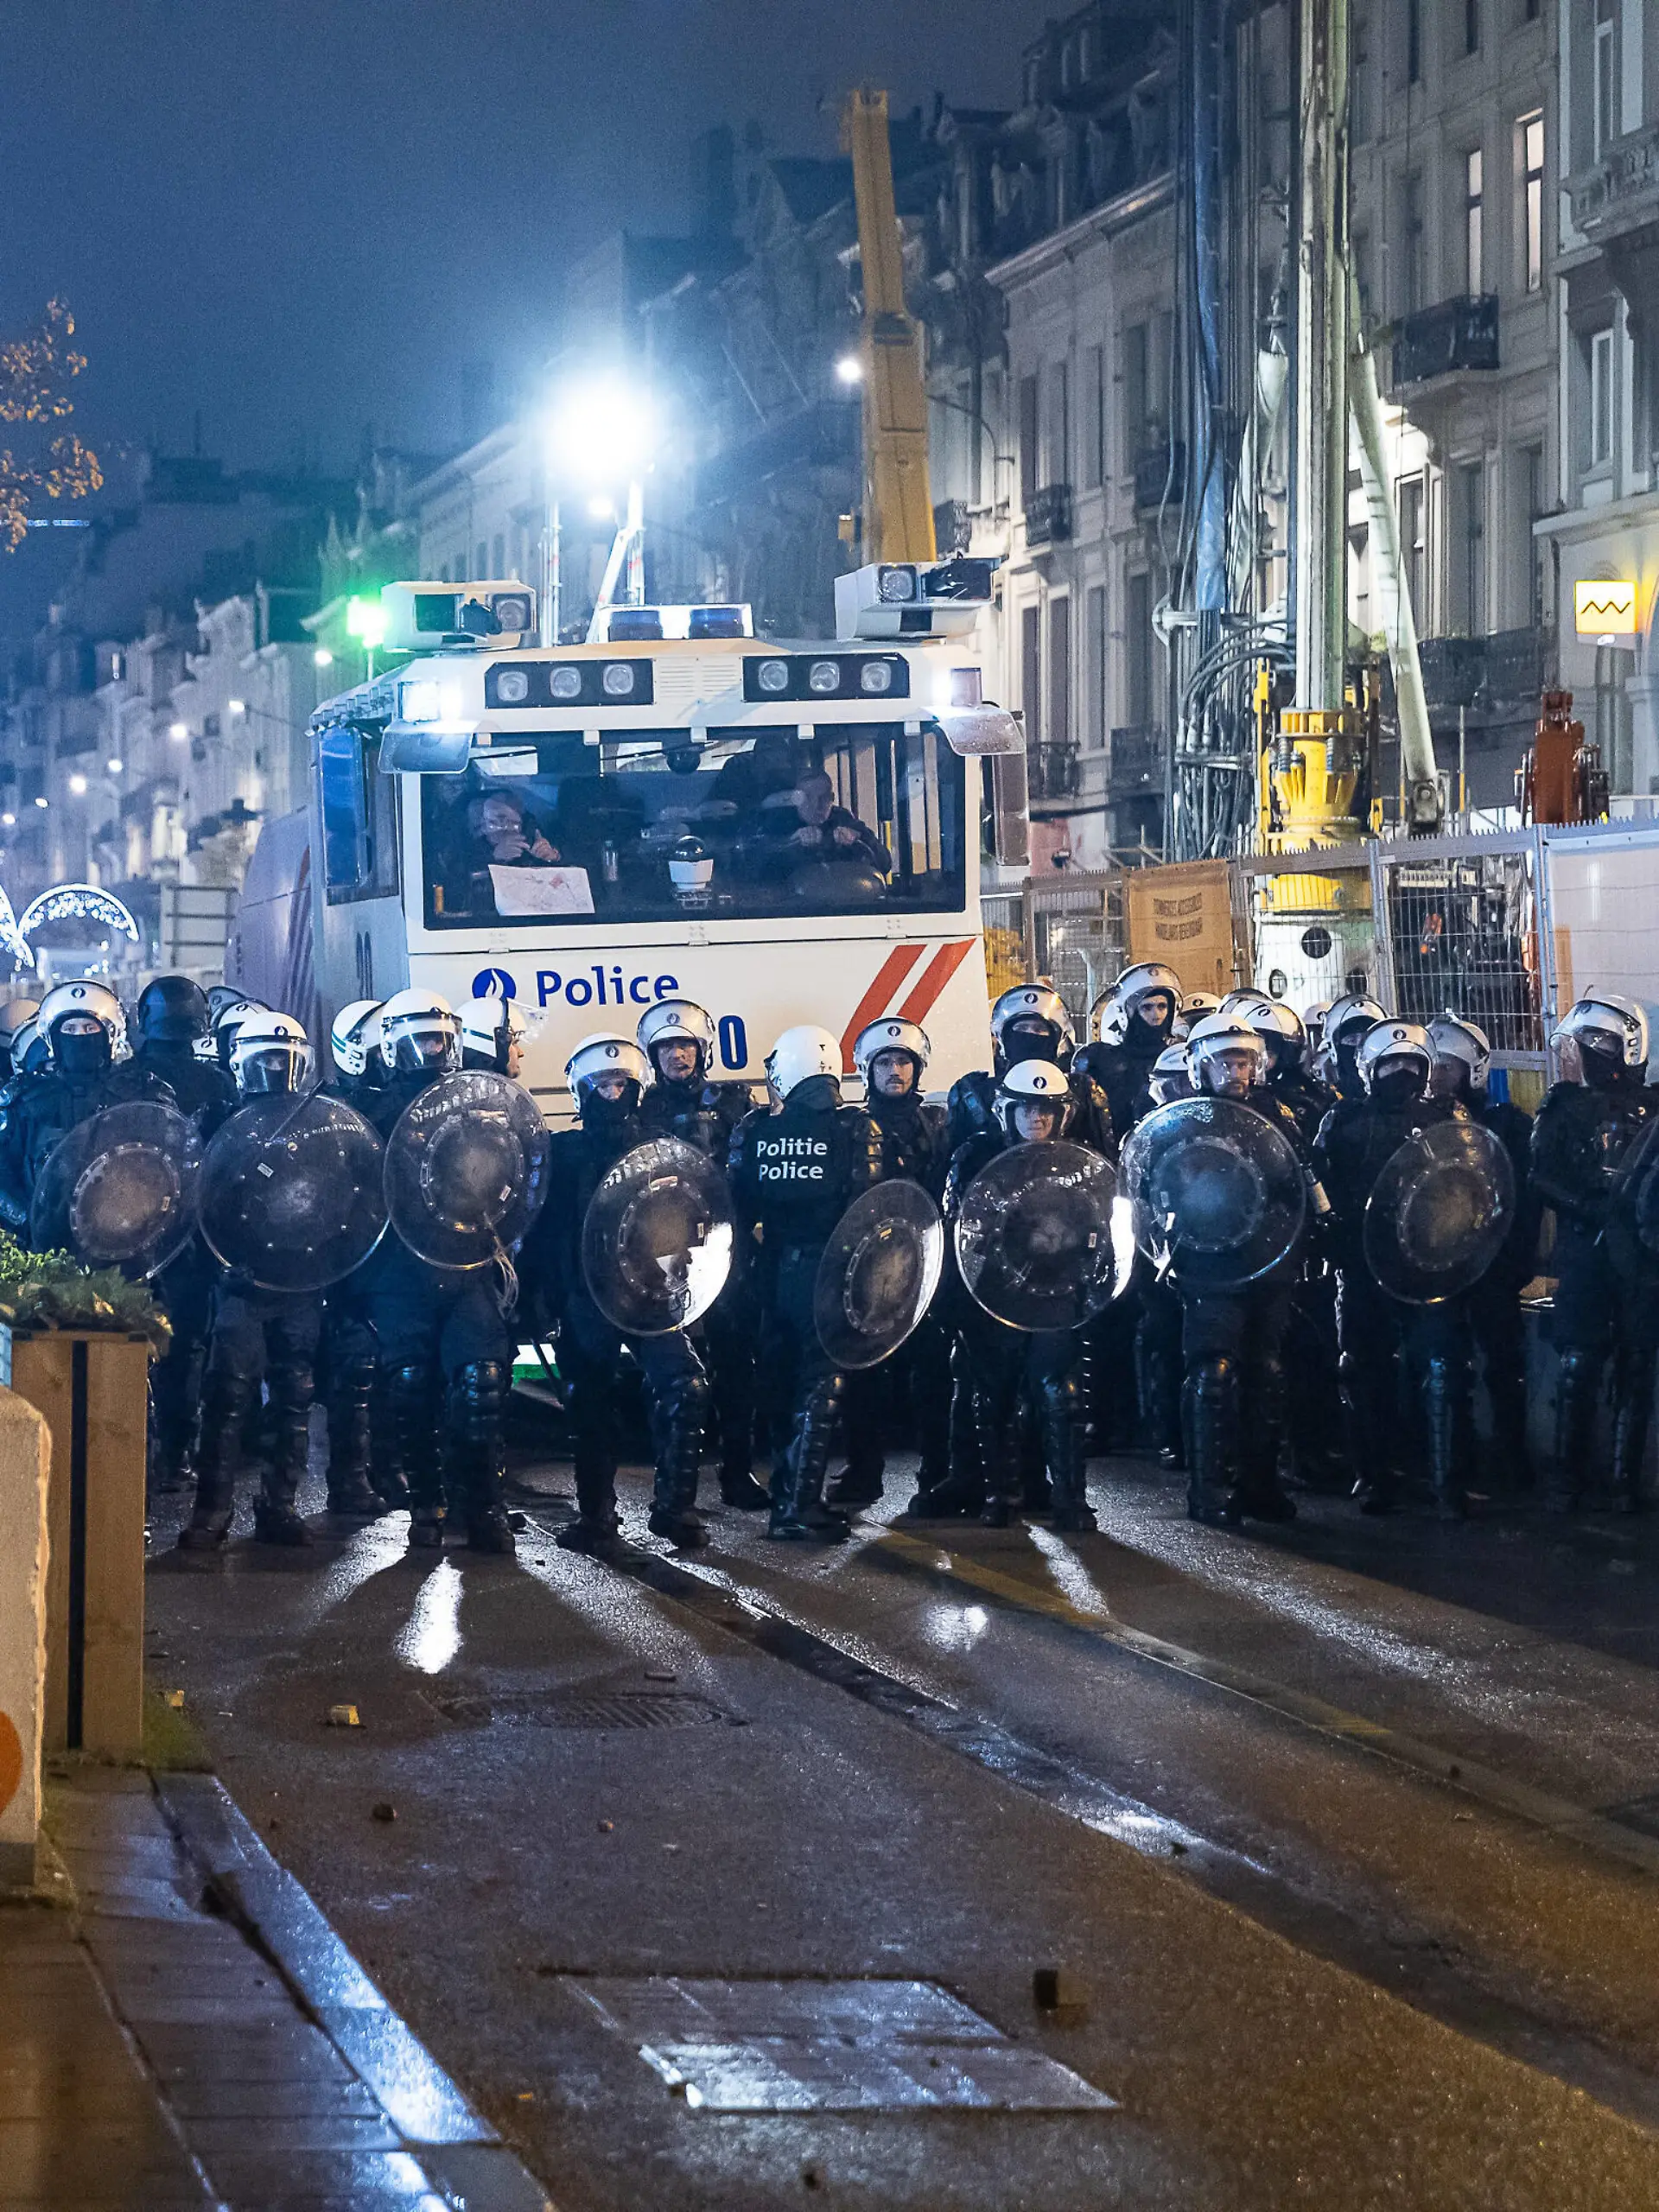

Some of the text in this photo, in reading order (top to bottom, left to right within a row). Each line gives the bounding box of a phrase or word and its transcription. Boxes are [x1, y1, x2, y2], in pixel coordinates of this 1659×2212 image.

[536, 965, 679, 1007] Police
[757, 1137, 828, 1157] Politie
[759, 1160, 823, 1181] Police
